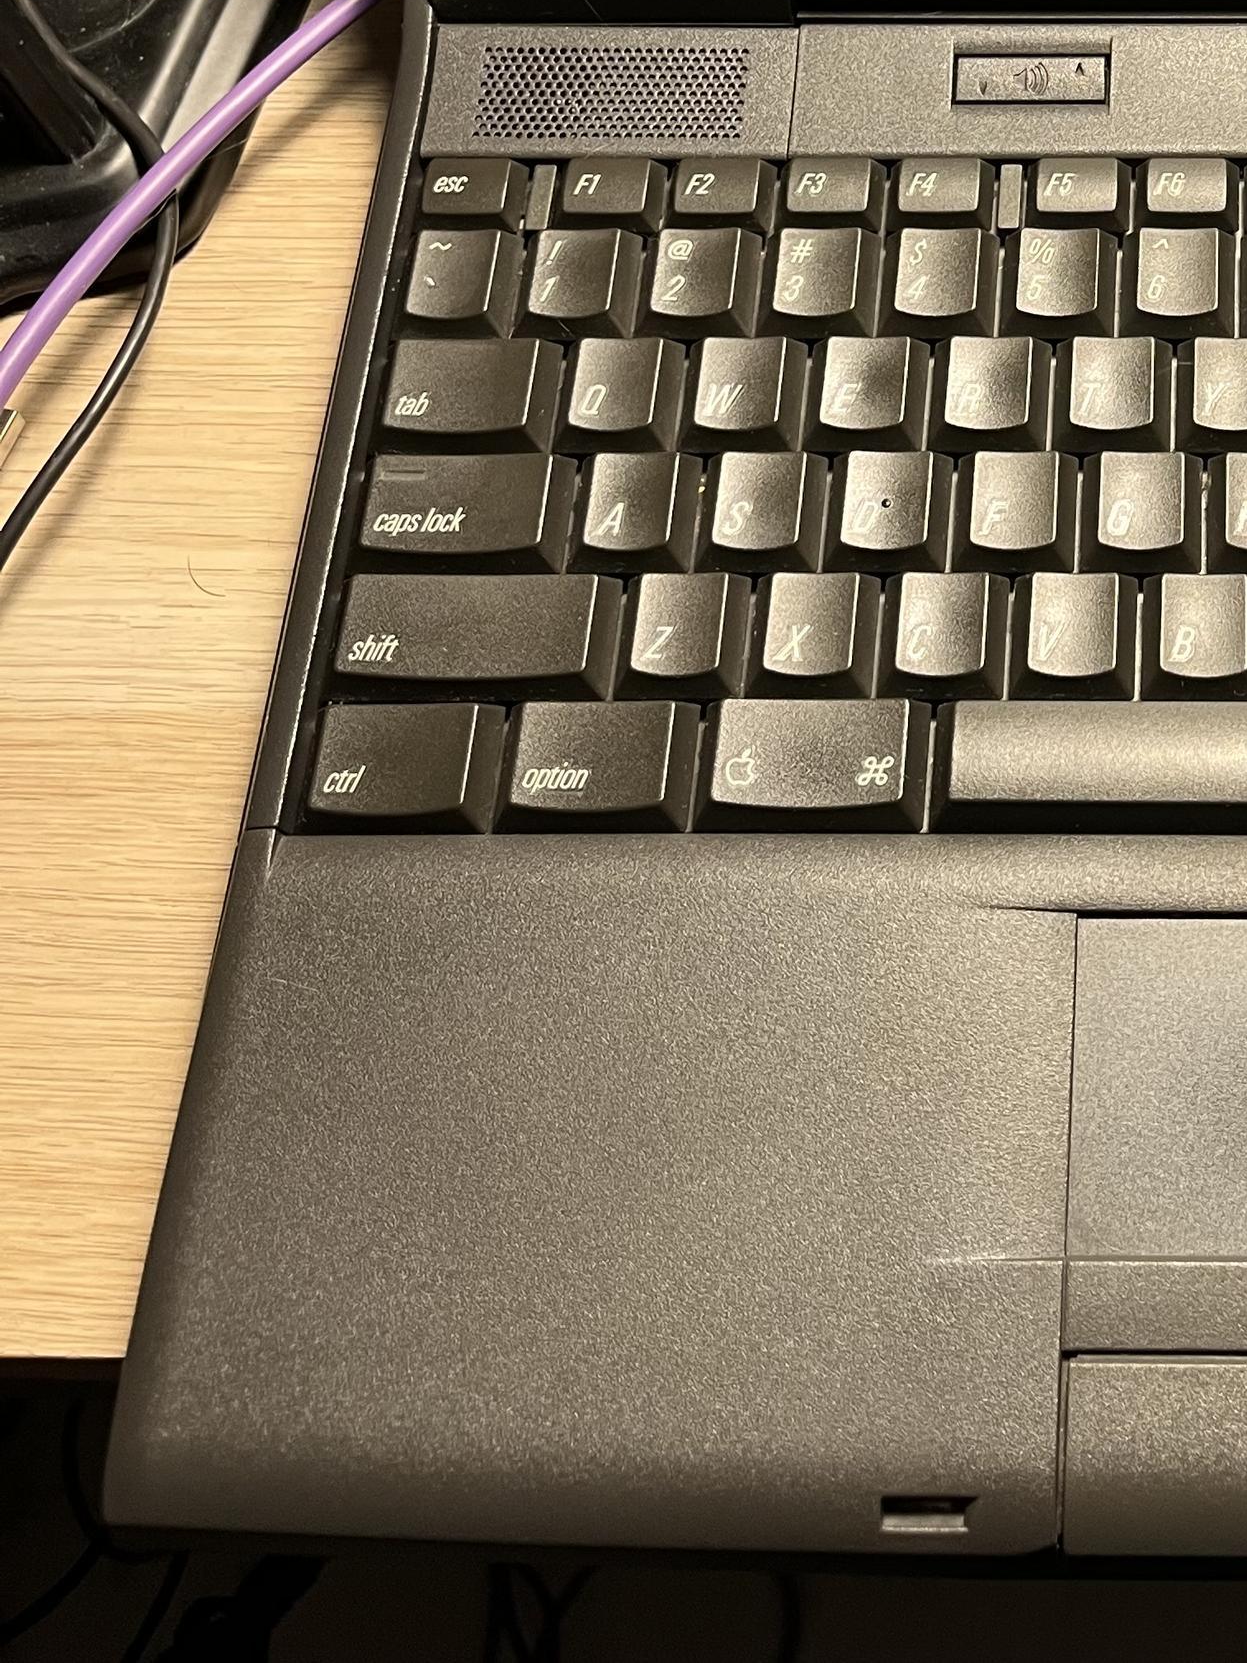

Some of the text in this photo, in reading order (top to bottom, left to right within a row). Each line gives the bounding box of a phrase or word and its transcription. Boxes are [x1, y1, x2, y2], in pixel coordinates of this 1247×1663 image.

[433, 174, 469, 192] esc
[574, 174, 602, 195] F1
[685, 174, 716, 196] F2
[797, 173, 827, 195] F3
[907, 173, 938, 196] F4
[1044, 173, 1074, 196] F5
[1154, 172, 1186, 196] F6
[540, 276, 561, 302] 1
[662, 276, 686, 302] 2
[783, 276, 804, 302] 3
[907, 276, 926, 302] 4
[1026, 275, 1045, 301] 5
[1146, 275, 1165, 301] 6
[395, 392, 430, 417] tab
[579, 384, 608, 417] Q
[706, 384, 744, 415] W
[1079, 384, 1107, 415] T
[1202, 384, 1229, 416] Y
[373, 507, 467, 532] caps lock
[597, 503, 626, 535] A
[725, 502, 752, 535] S
[850, 500, 878, 534] D
[980, 500, 1008, 535] F
[1107, 500, 1134, 535] G
[348, 634, 400, 663] shift
[642, 626, 677, 659] Z
[775, 625, 811, 661] X
[906, 625, 934, 659] C
[1037, 624, 1067, 661] V
[1170, 625, 1198, 662] B
[323, 766, 366, 793] ctrl
[521, 762, 590, 792] option
